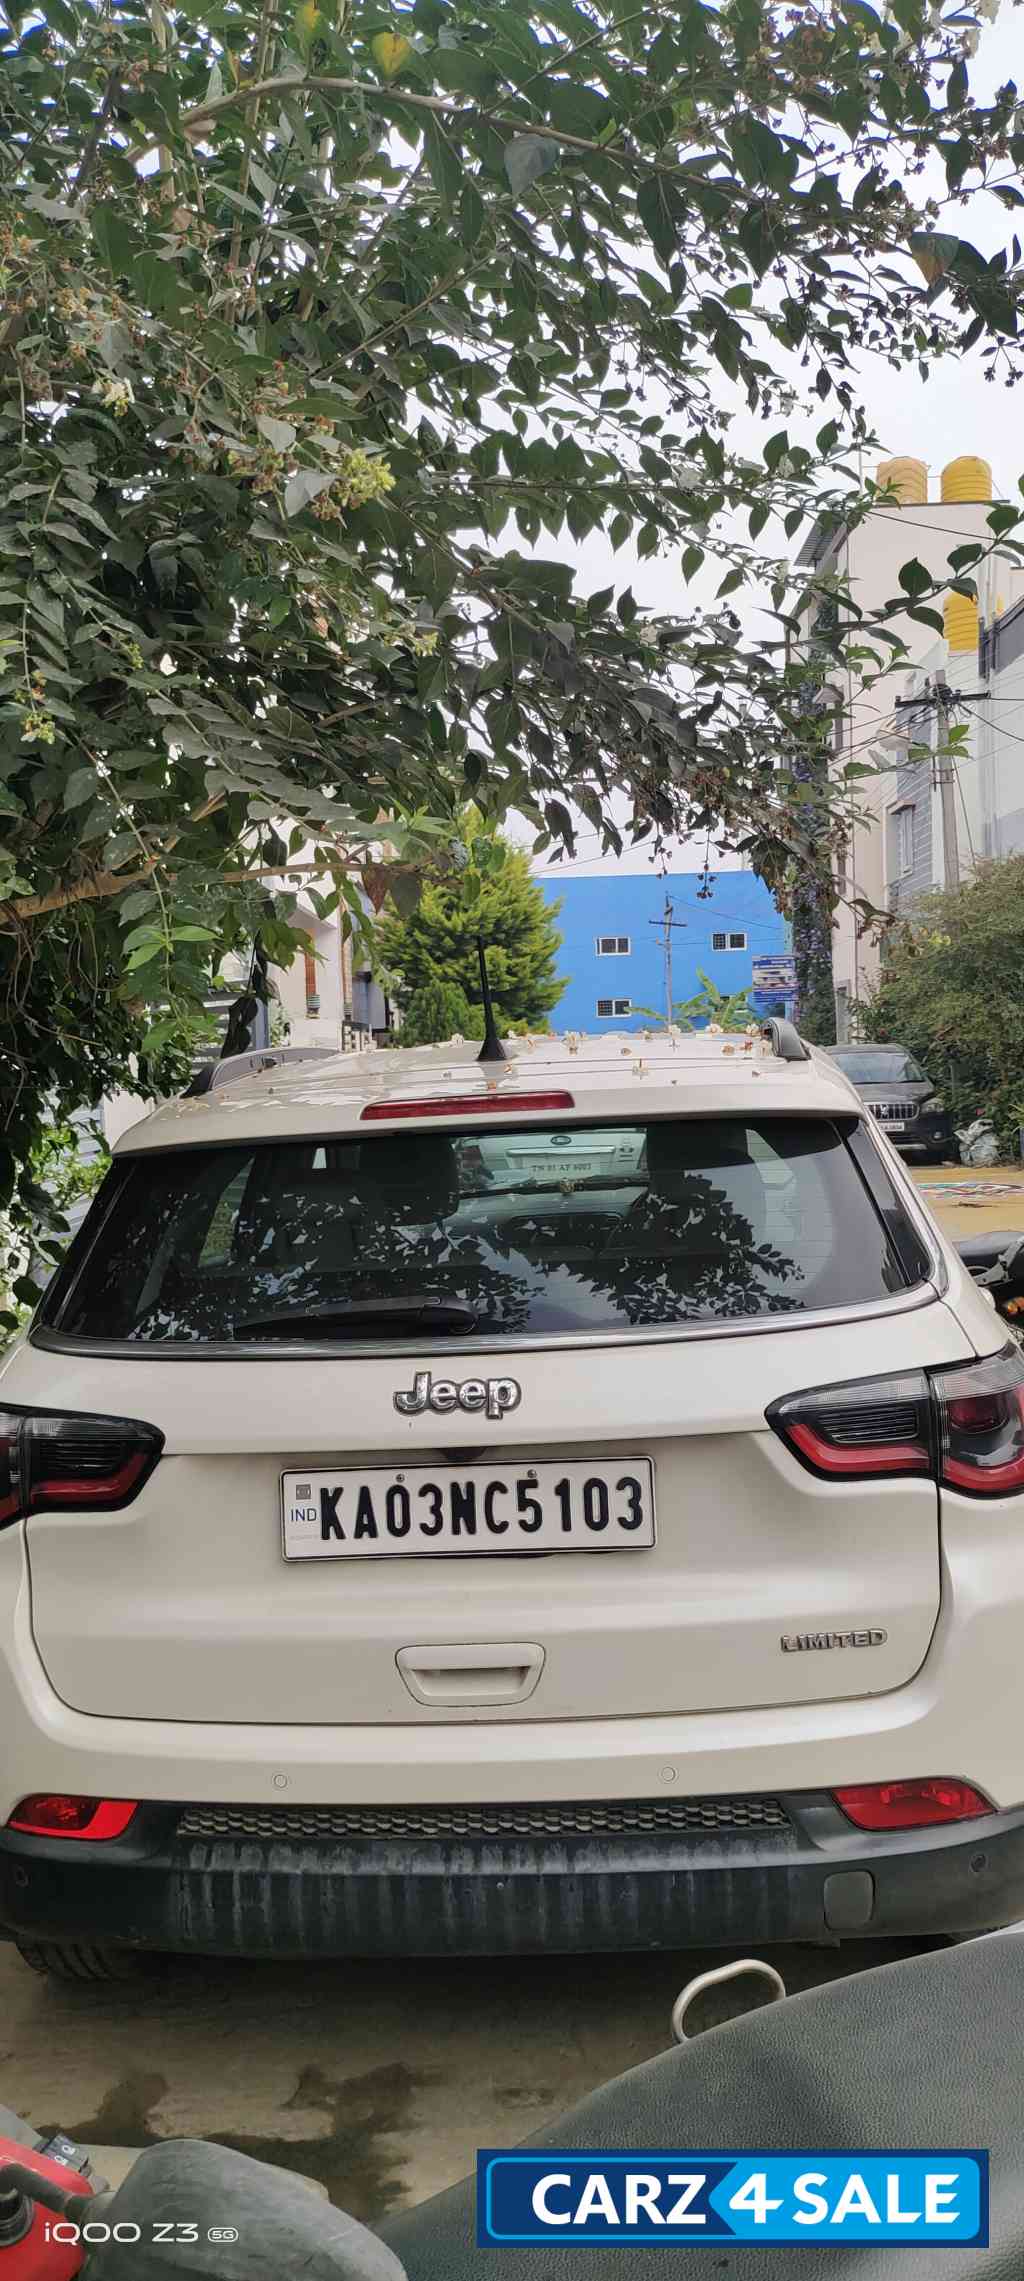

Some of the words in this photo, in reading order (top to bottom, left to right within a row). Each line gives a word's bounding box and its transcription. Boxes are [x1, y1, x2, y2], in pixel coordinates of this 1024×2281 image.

[394, 1371, 522, 1419] Jeep
[290, 1508, 317, 1522] IND
[320, 1476, 643, 1540] KA03NC5103
[781, 1628, 888, 1652] LIMITED
